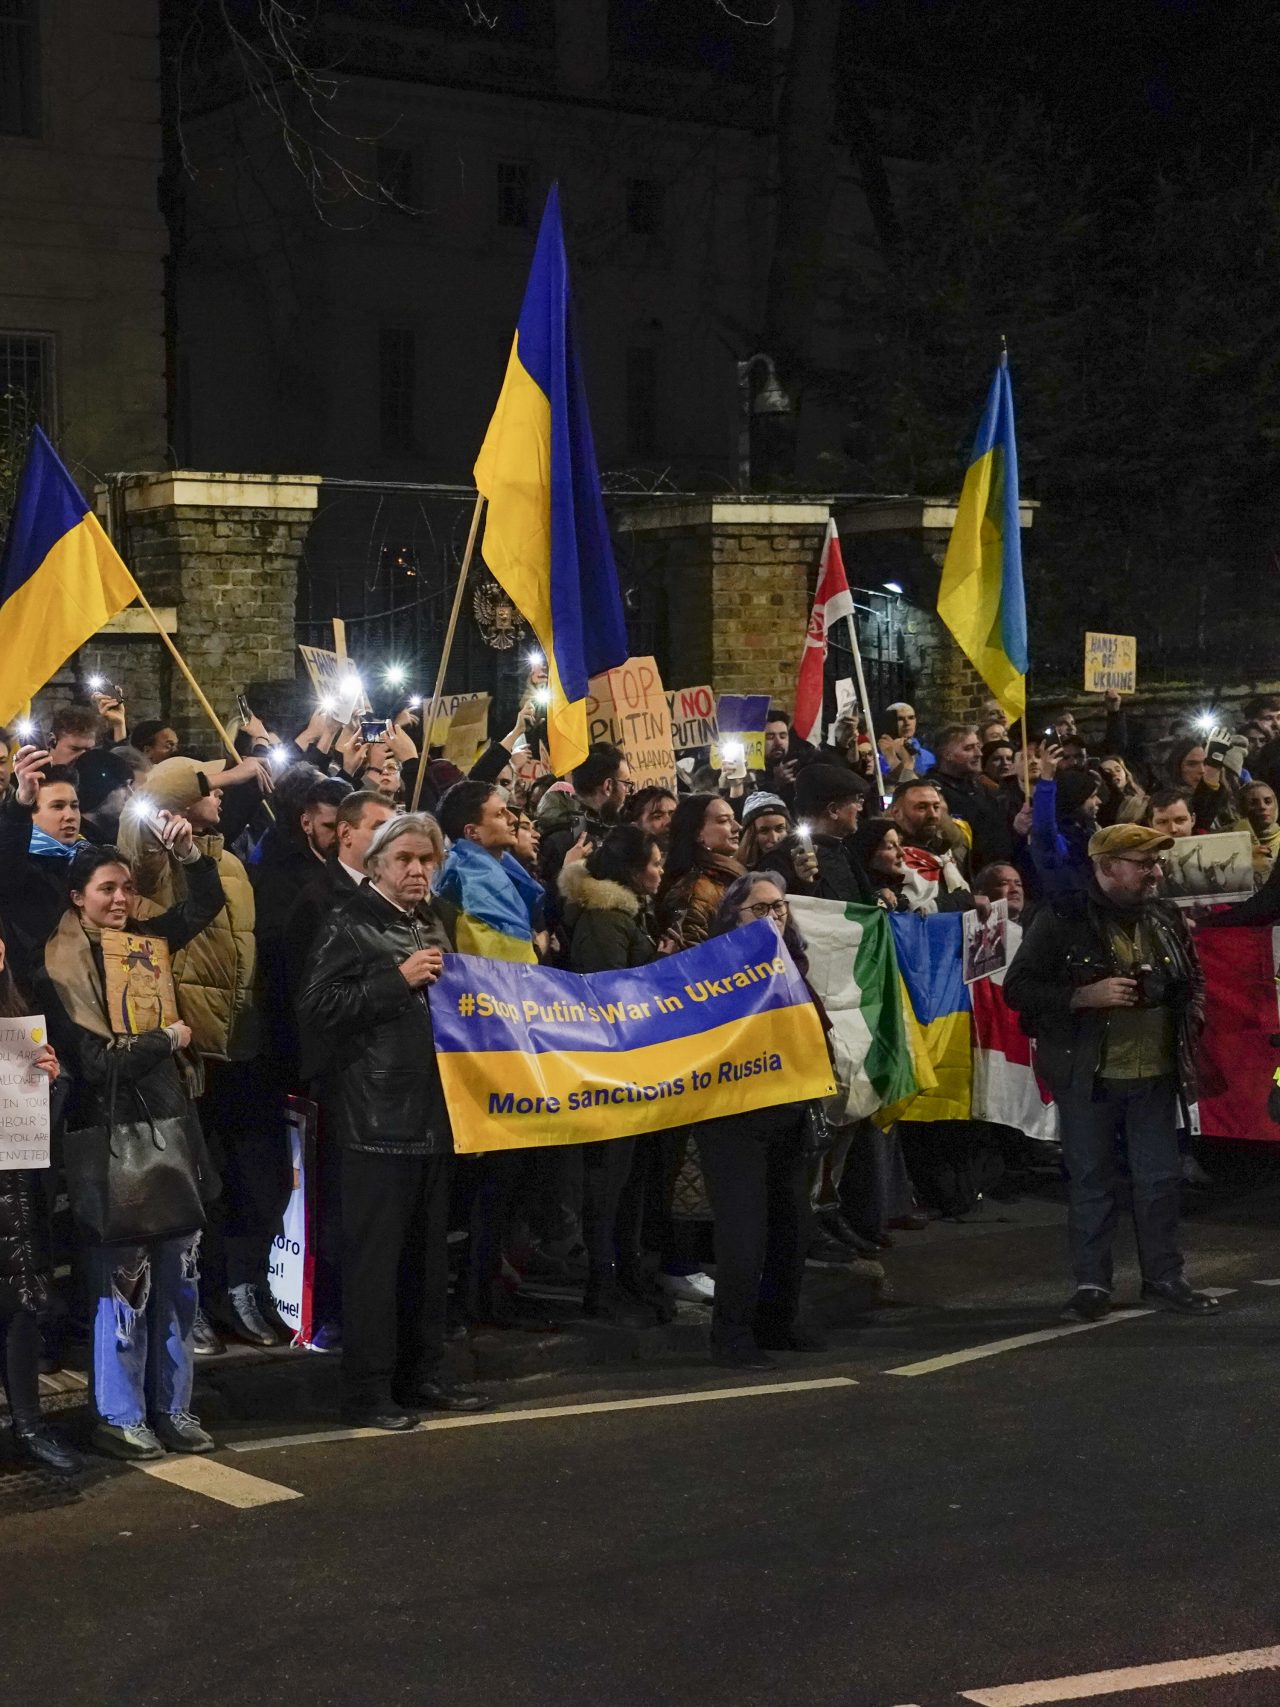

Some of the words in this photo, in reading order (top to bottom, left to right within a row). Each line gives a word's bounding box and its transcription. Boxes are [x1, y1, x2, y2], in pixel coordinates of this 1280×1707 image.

[681, 688, 712, 718] NO
[590, 712, 664, 746] PUTIN
[671, 717, 720, 747] PUTIN
[458, 992, 519, 1024] #Stop
[522, 1000, 600, 1024] Putin's
[597, 1001, 651, 1024] War
[654, 996, 684, 1015] in
[684, 957, 786, 1003] Ukraine
[488, 1092, 561, 1115] More
[568, 1078, 685, 1110] sanctions
[691, 1070, 712, 1090] to
[718, 1051, 783, 1084] Russia
[3, 1098, 18, 1109] IN
[24, 1097, 47, 1108] YOUR
[9, 1133, 31, 1143] YOU
[34, 1133, 49, 1141] ARE
